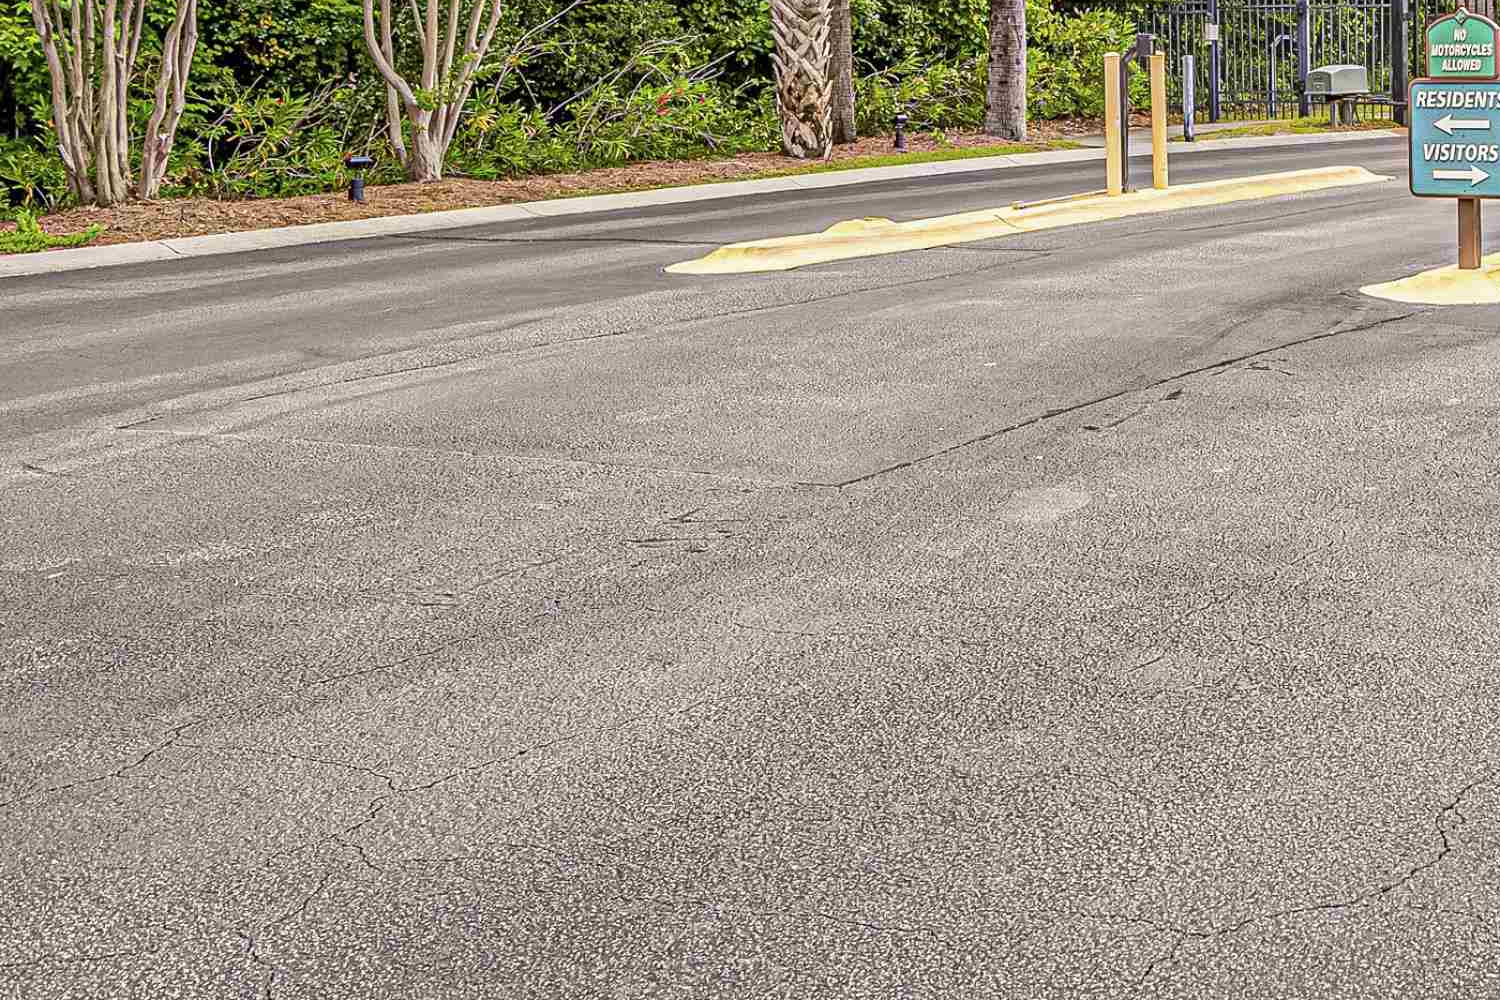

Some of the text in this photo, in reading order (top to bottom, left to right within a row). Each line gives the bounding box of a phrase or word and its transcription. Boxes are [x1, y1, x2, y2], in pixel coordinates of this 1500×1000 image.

[1453, 28, 1467, 41] NO
[1431, 43, 1493, 57] MOTORCYCLES
[1441, 57, 1482, 71] ALLOWED
[1423, 143, 1499, 162] VISITORS
